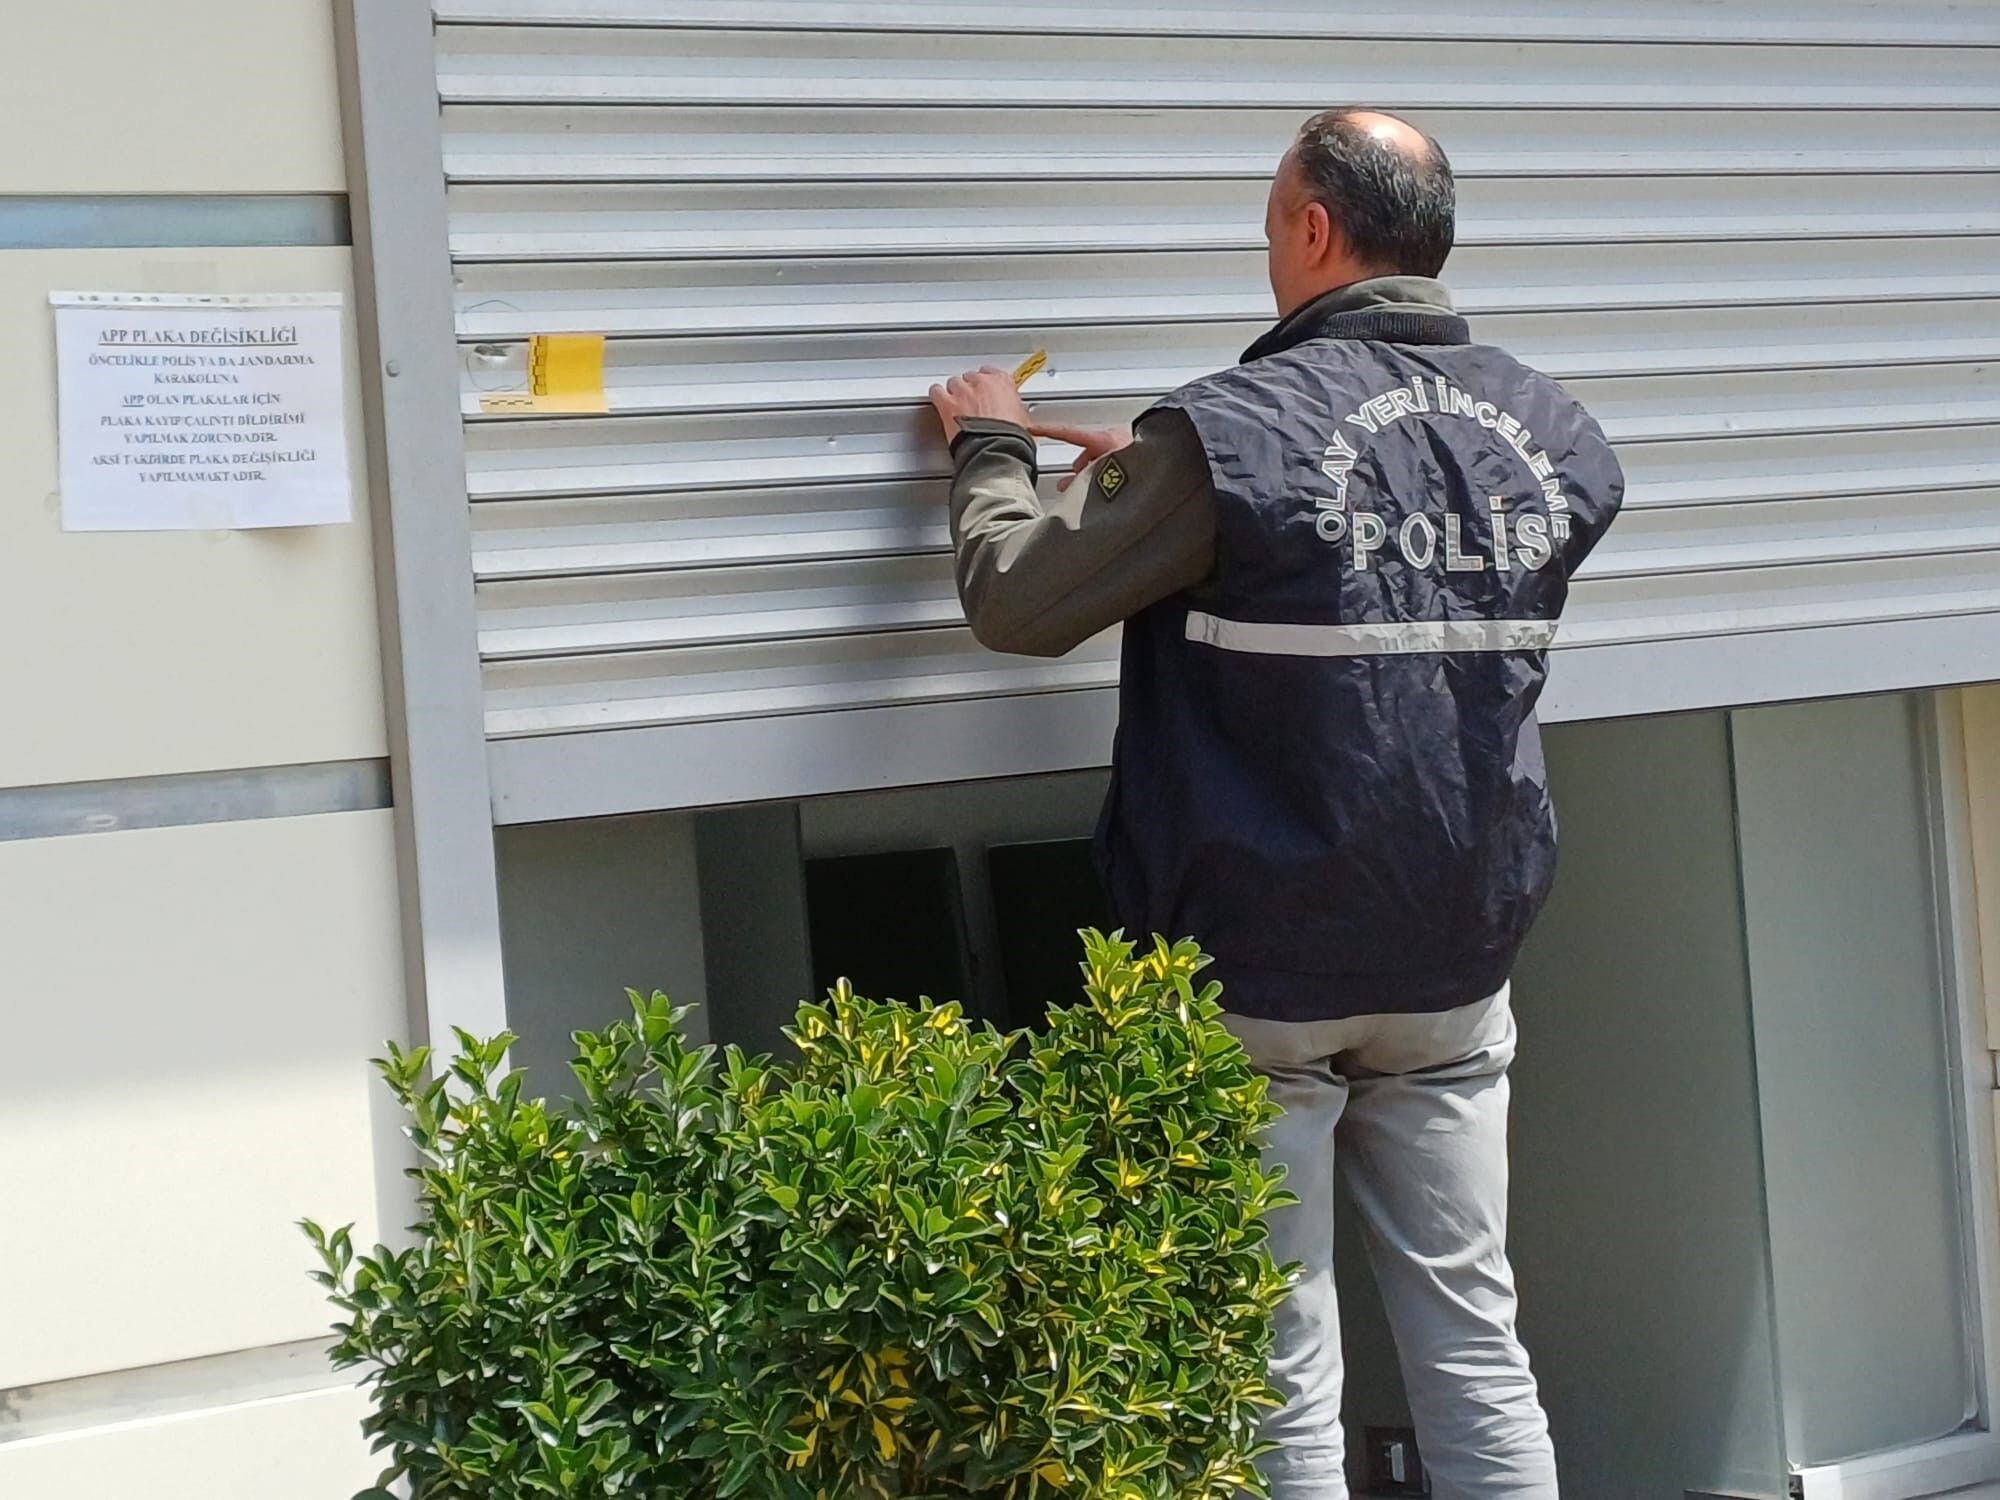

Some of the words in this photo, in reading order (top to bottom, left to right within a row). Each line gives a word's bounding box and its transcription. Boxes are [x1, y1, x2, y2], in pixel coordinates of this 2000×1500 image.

[98, 329, 131, 345] APP
[146, 394, 179, 404] OLAN
[183, 393, 249, 404] PLAKALAR
[100, 416, 143, 426] PLAKA
[1315, 429, 1358, 542] OLAY
[1345, 376, 1430, 434] YERİ
[1435, 375, 1571, 540] İNCELEME
[1353, 496, 1551, 571] POLİS
